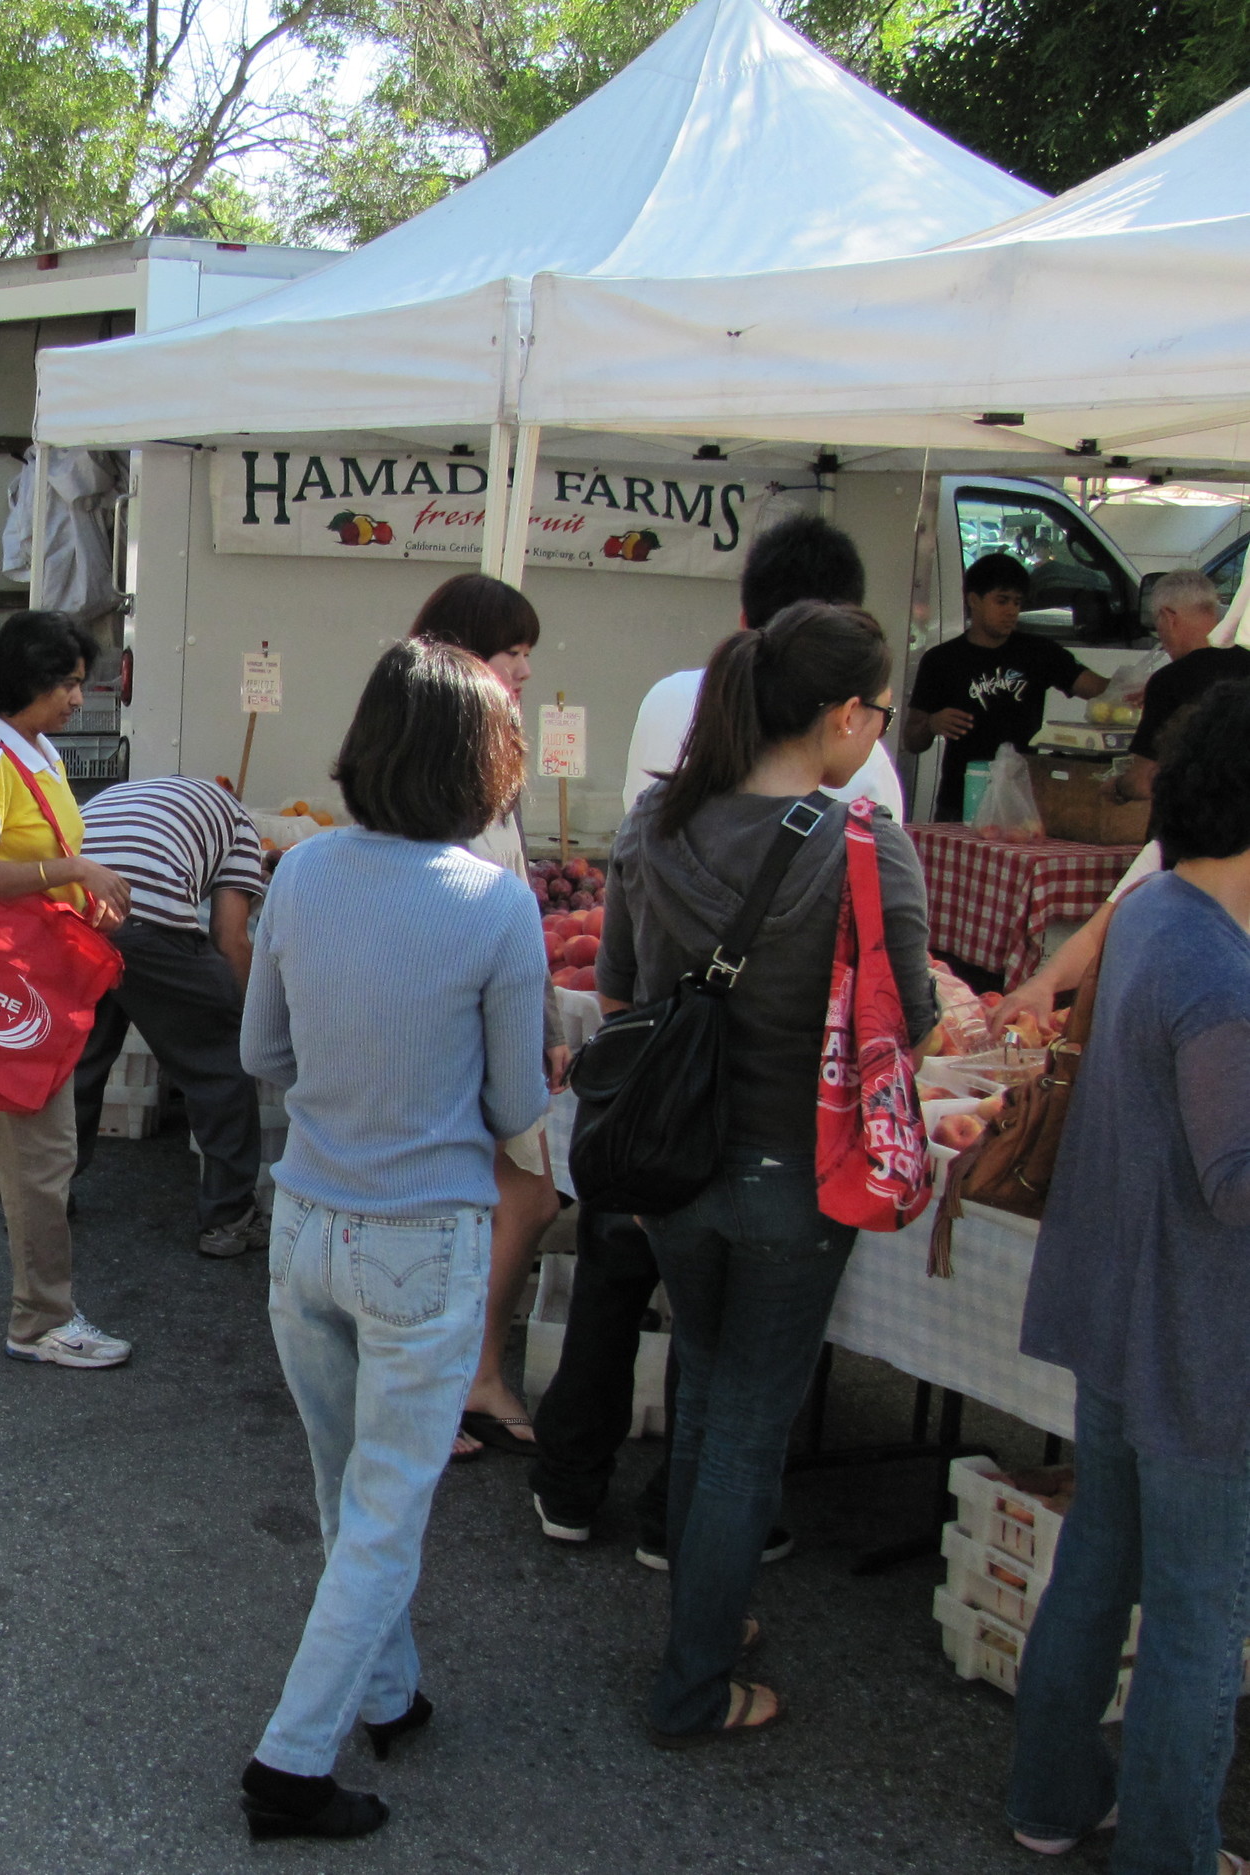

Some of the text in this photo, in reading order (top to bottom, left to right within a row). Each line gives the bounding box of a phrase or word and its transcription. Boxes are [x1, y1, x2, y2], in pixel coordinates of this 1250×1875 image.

[241, 450, 746, 552] HAMAD FARMS
[527, 506, 586, 534] ruit
[405, 540, 446, 552] California
[449, 543, 484, 553] Certifie
[579, 551, 591, 561] CA
